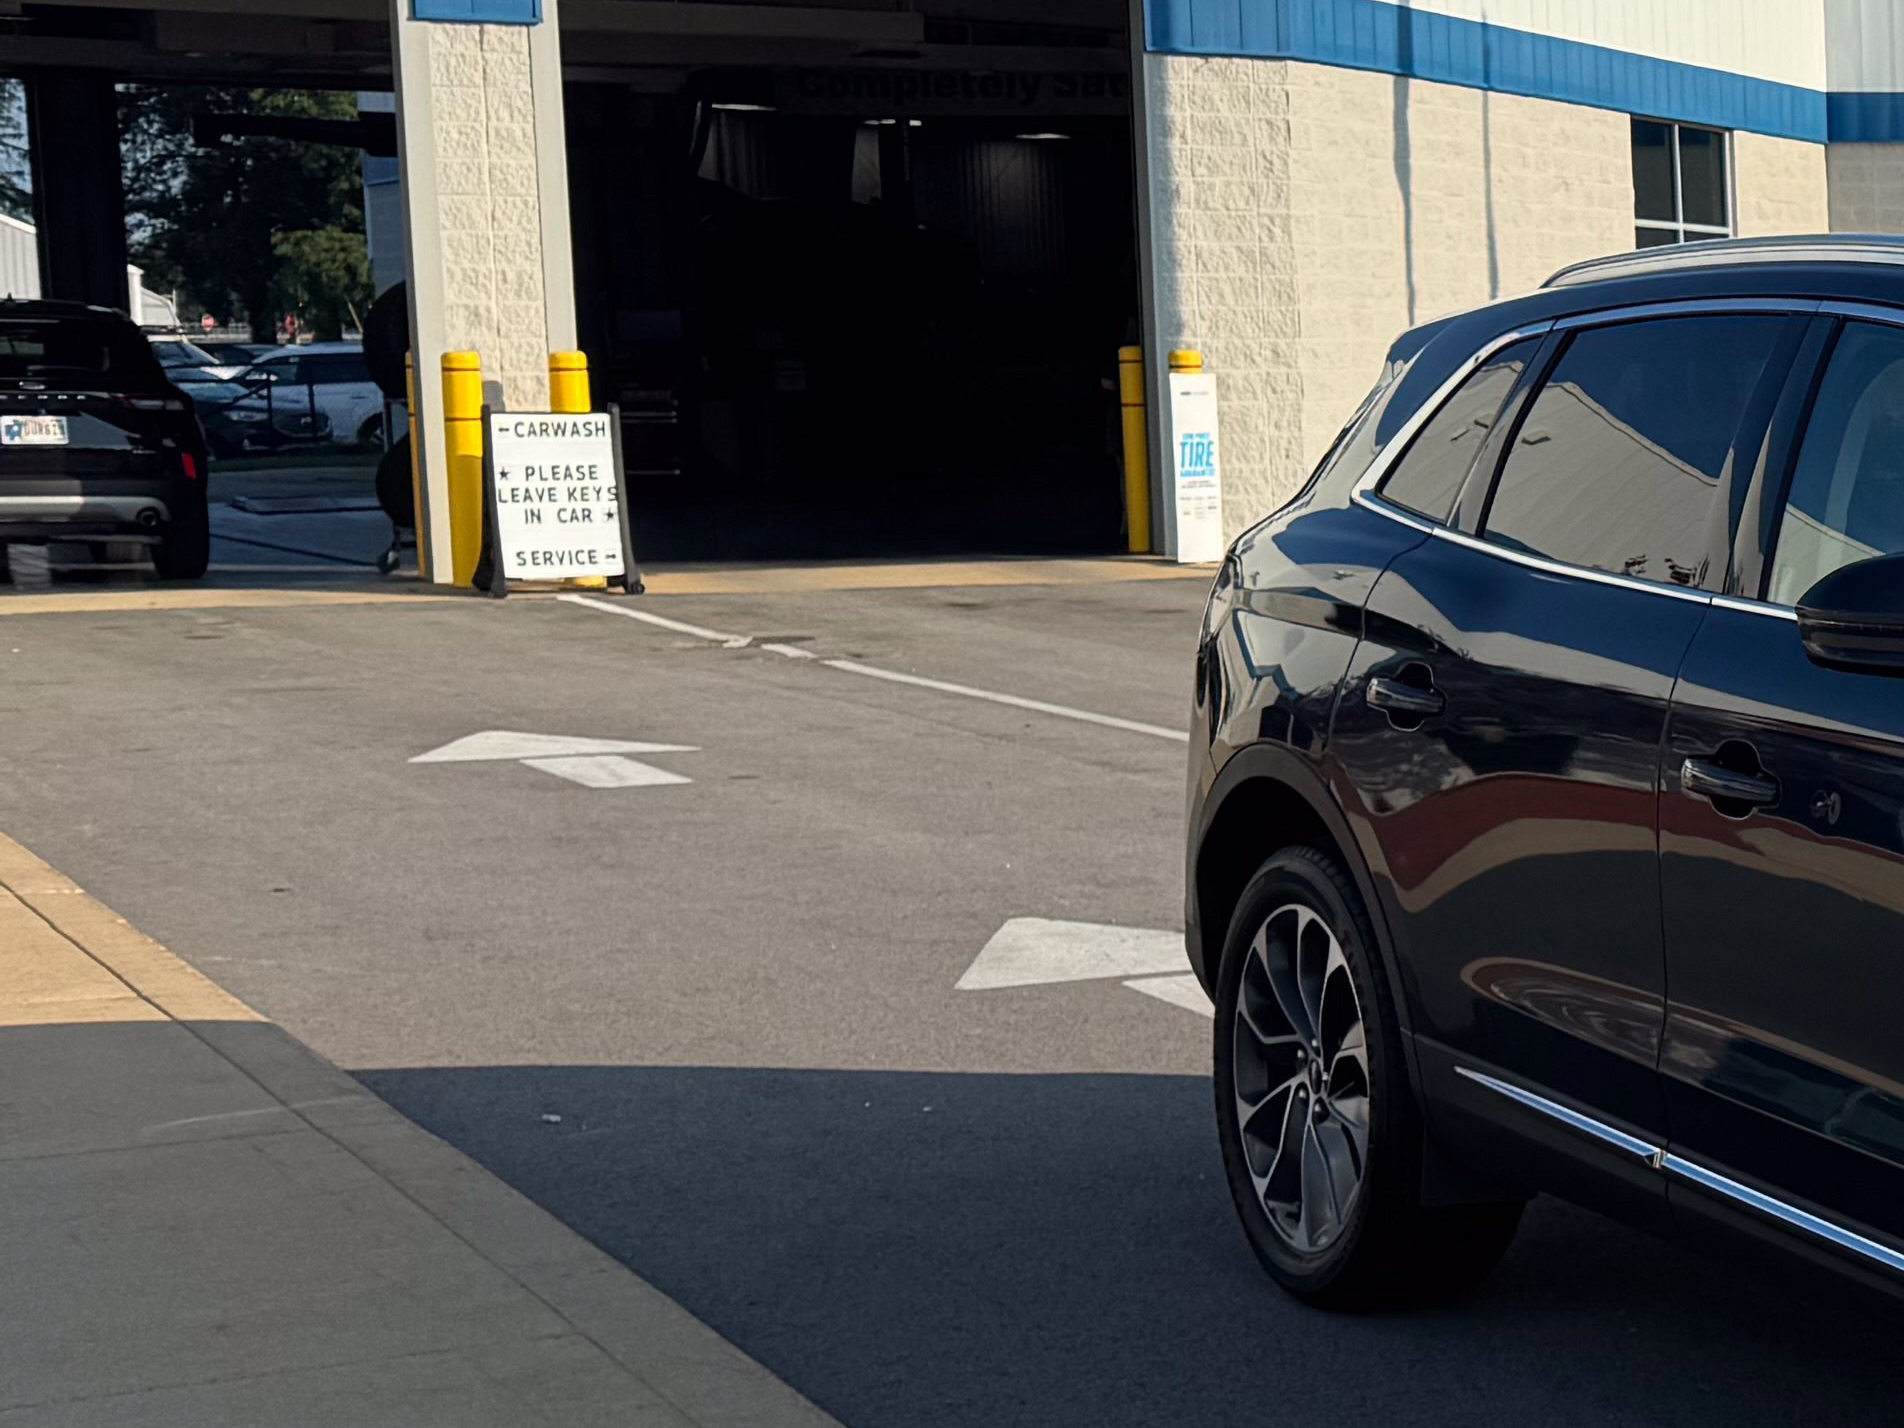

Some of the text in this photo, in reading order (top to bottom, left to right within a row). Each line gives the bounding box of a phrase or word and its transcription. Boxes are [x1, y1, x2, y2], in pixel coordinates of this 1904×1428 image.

[514, 421, 606, 438] CARWASH
[1180, 441, 1214, 469] TIRE
[525, 464, 599, 482] PLEASE
[498, 485, 618, 504] LEAVE KEYS
[524, 507, 593, 524] IN CAR
[516, 549, 599, 566] SERVICE
